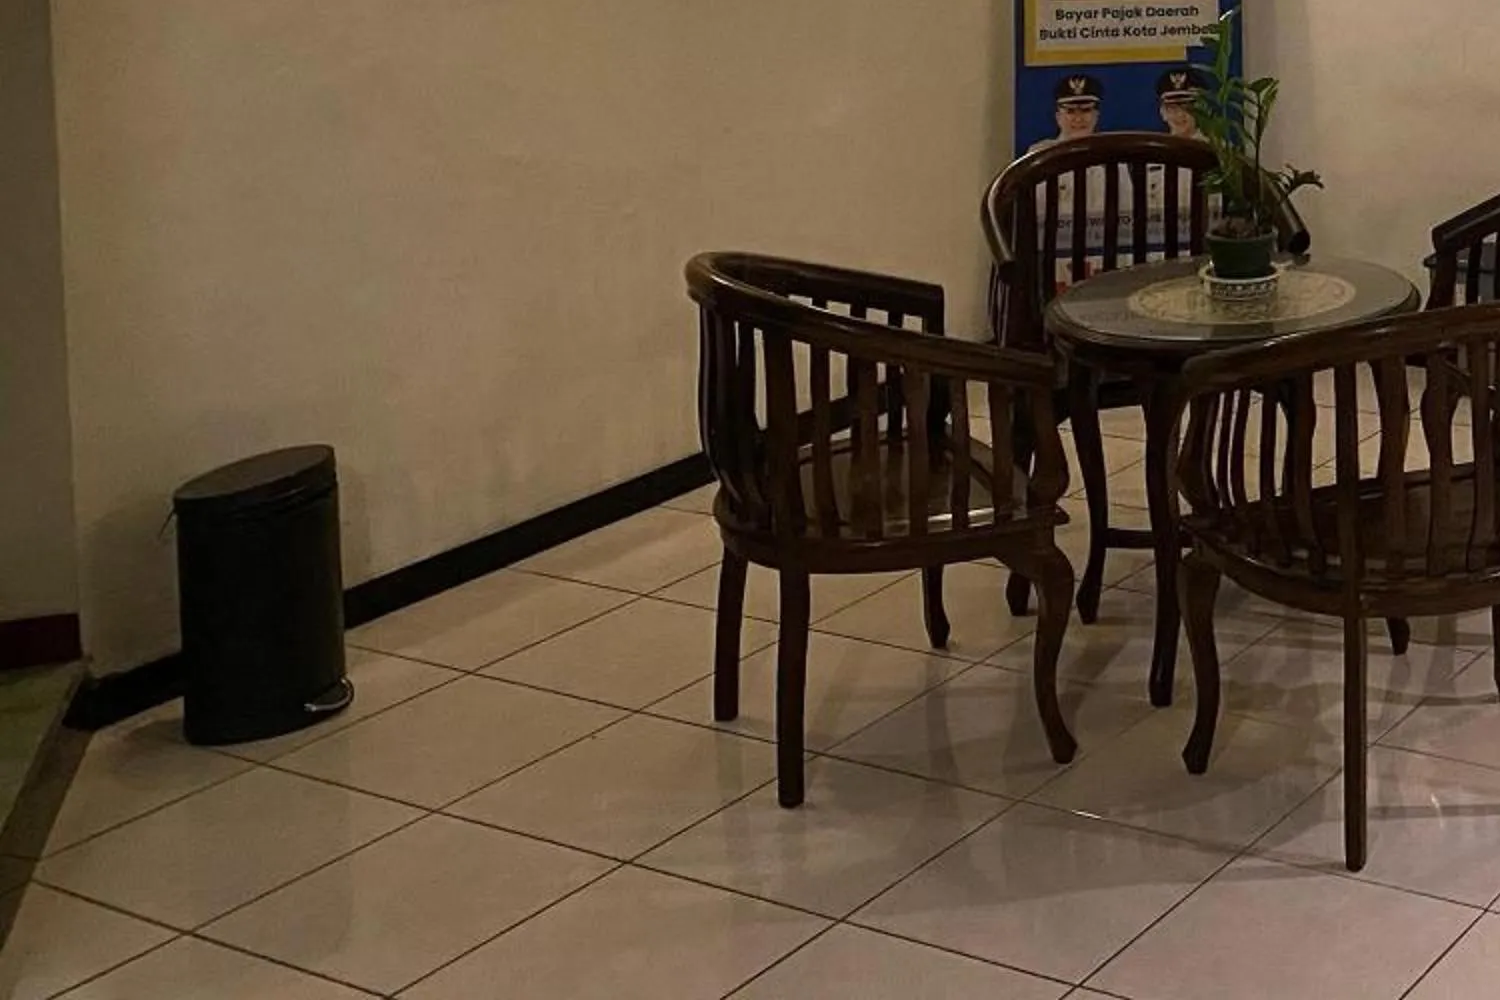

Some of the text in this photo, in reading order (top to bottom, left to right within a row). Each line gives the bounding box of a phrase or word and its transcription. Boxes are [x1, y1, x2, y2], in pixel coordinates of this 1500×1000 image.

[1055, 5, 1199, 23] Bayar Pajak Daerah
[1040, 27, 1077, 40] Bukti
[1079, 26, 1119, 39] Cinta
[1123, 25, 1157, 37] Kota
